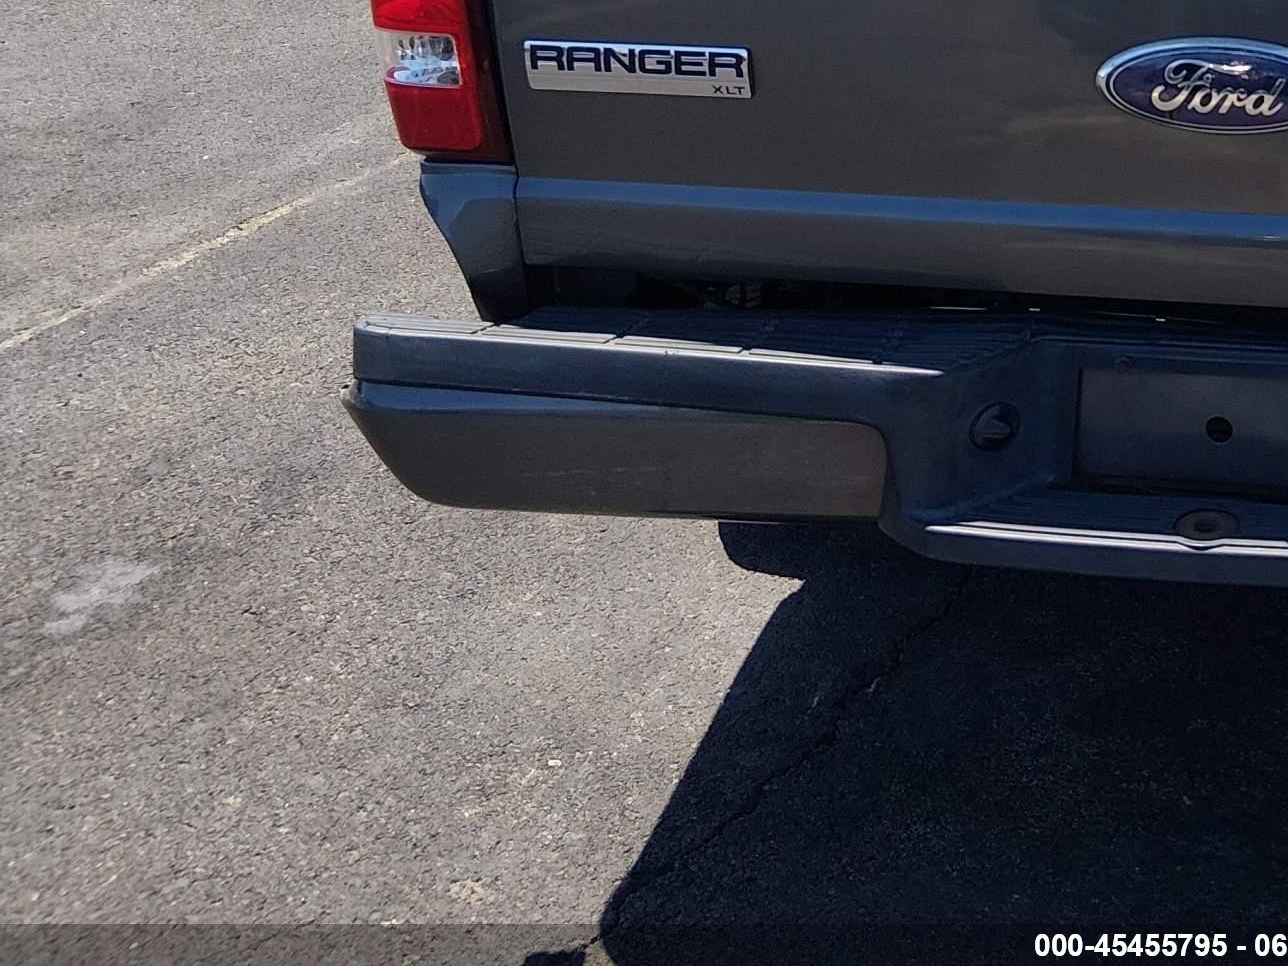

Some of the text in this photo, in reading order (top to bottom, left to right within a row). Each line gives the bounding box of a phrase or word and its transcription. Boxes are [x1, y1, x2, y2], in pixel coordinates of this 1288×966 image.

[529, 44, 746, 78] RANGER
[712, 84, 746, 96] XLT
[1151, 58, 1287, 117] Ford
